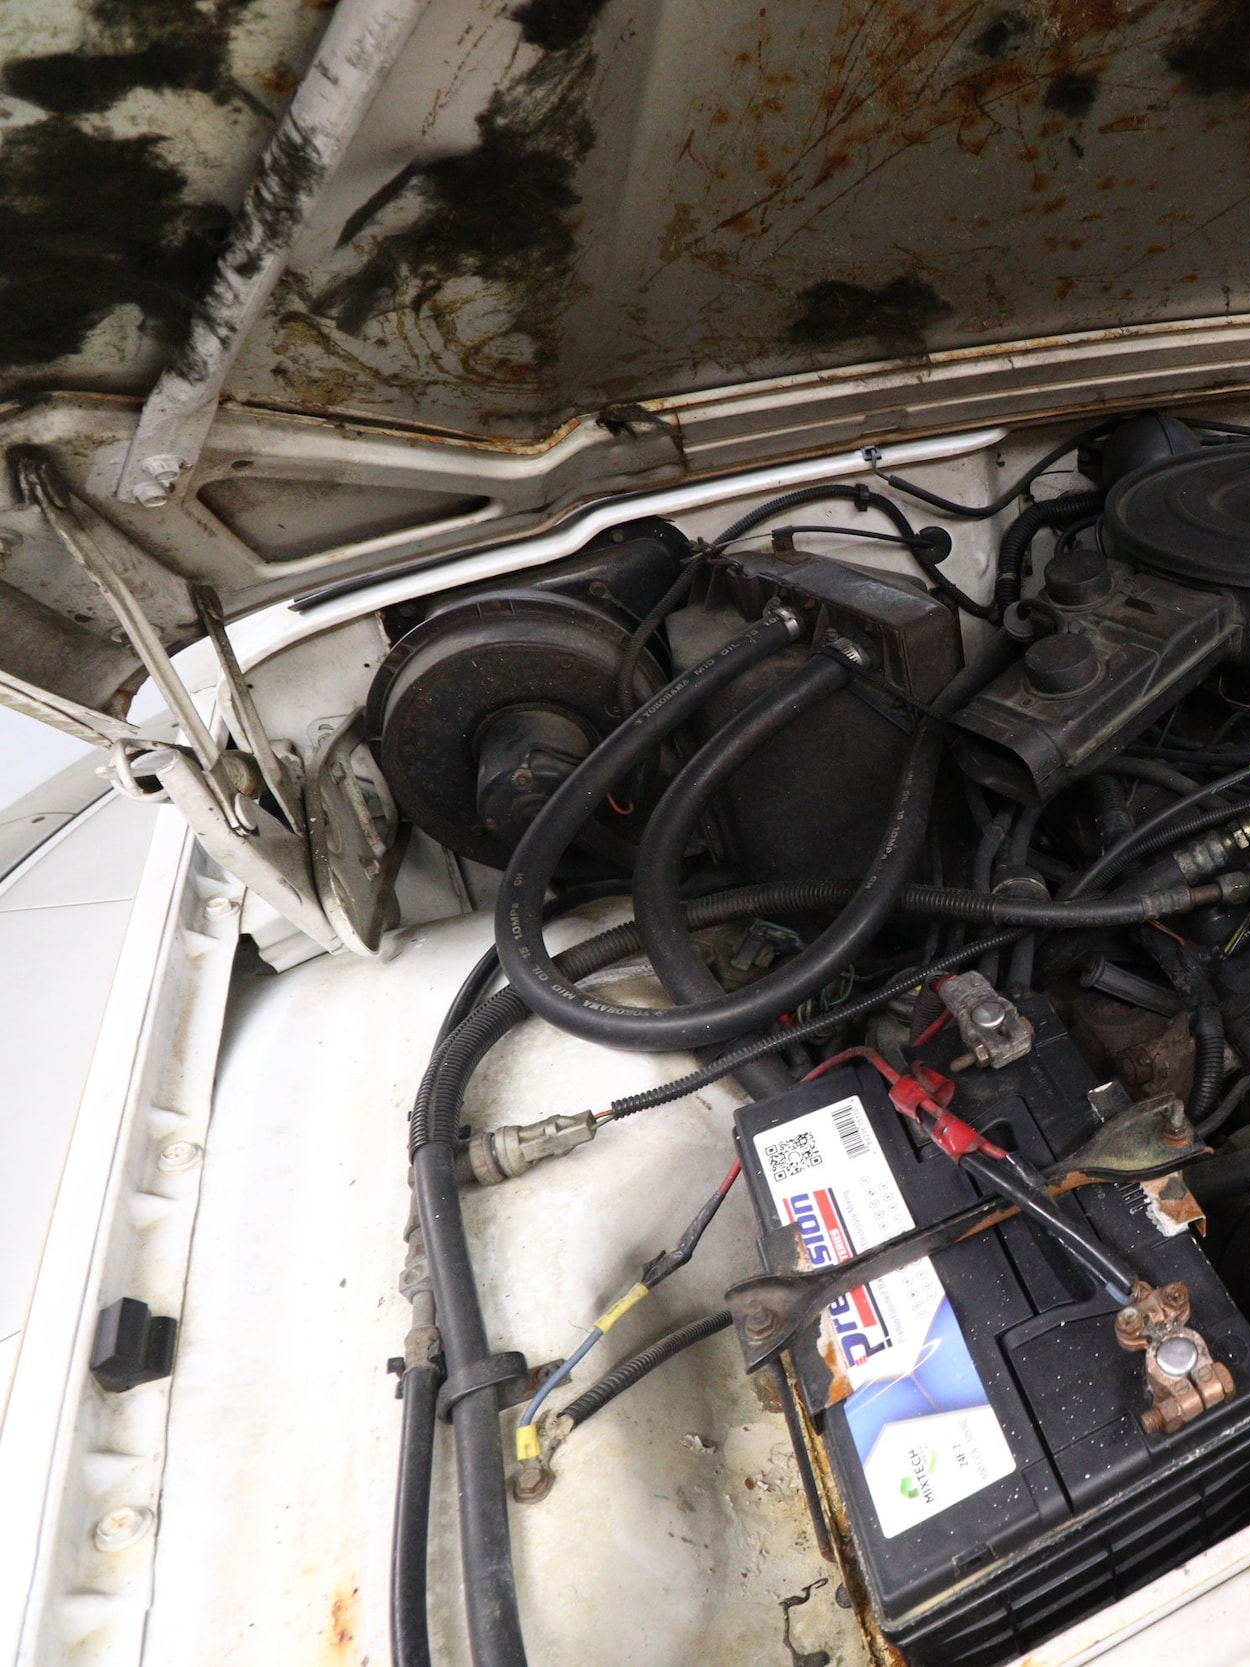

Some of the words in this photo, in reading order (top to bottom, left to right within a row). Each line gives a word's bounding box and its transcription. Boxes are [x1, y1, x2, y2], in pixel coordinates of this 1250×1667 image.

[643, 678, 690, 718] YOKOHAMA
[694, 659, 716, 676] MID
[720, 642, 740, 656] OIL
[519, 946, 531, 960] 15
[532, 964, 549, 982] OIL
[551, 984, 577, 1001] MID
[829, 1228, 850, 1261] TERIES
[952, 1444, 969, 1469] 24F-7
[908, 1449, 935, 1504] MIXTECH
